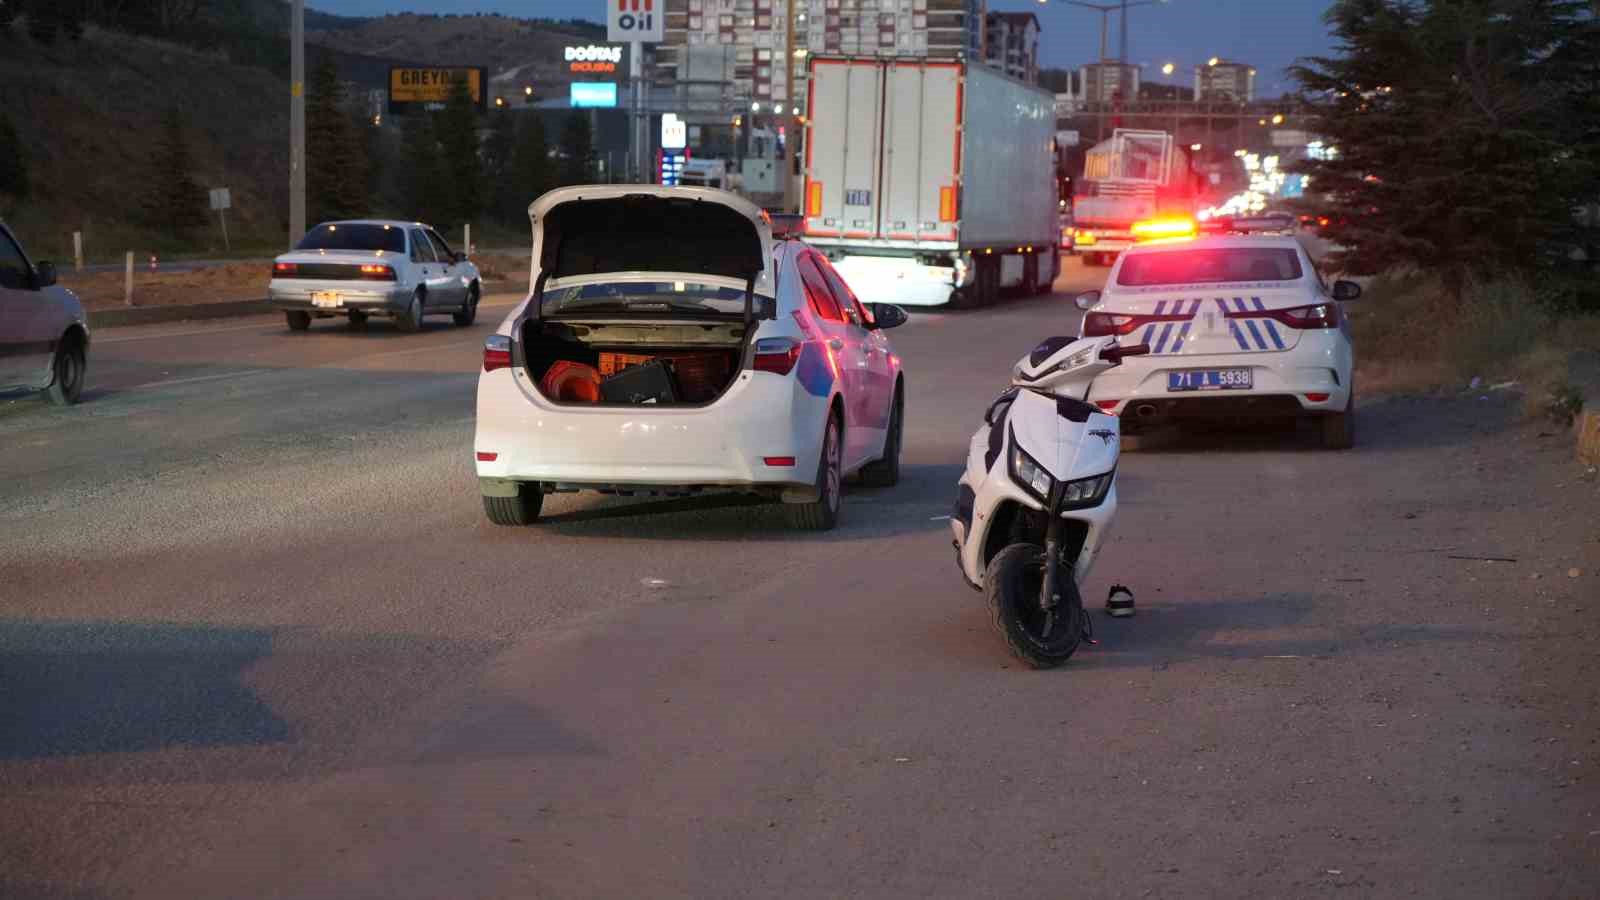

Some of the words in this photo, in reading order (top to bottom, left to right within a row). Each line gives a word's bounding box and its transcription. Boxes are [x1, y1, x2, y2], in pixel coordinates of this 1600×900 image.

[1177, 372, 1192, 387] 71
[1202, 371, 1210, 386] A
[1219, 370, 1249, 385] 5938
